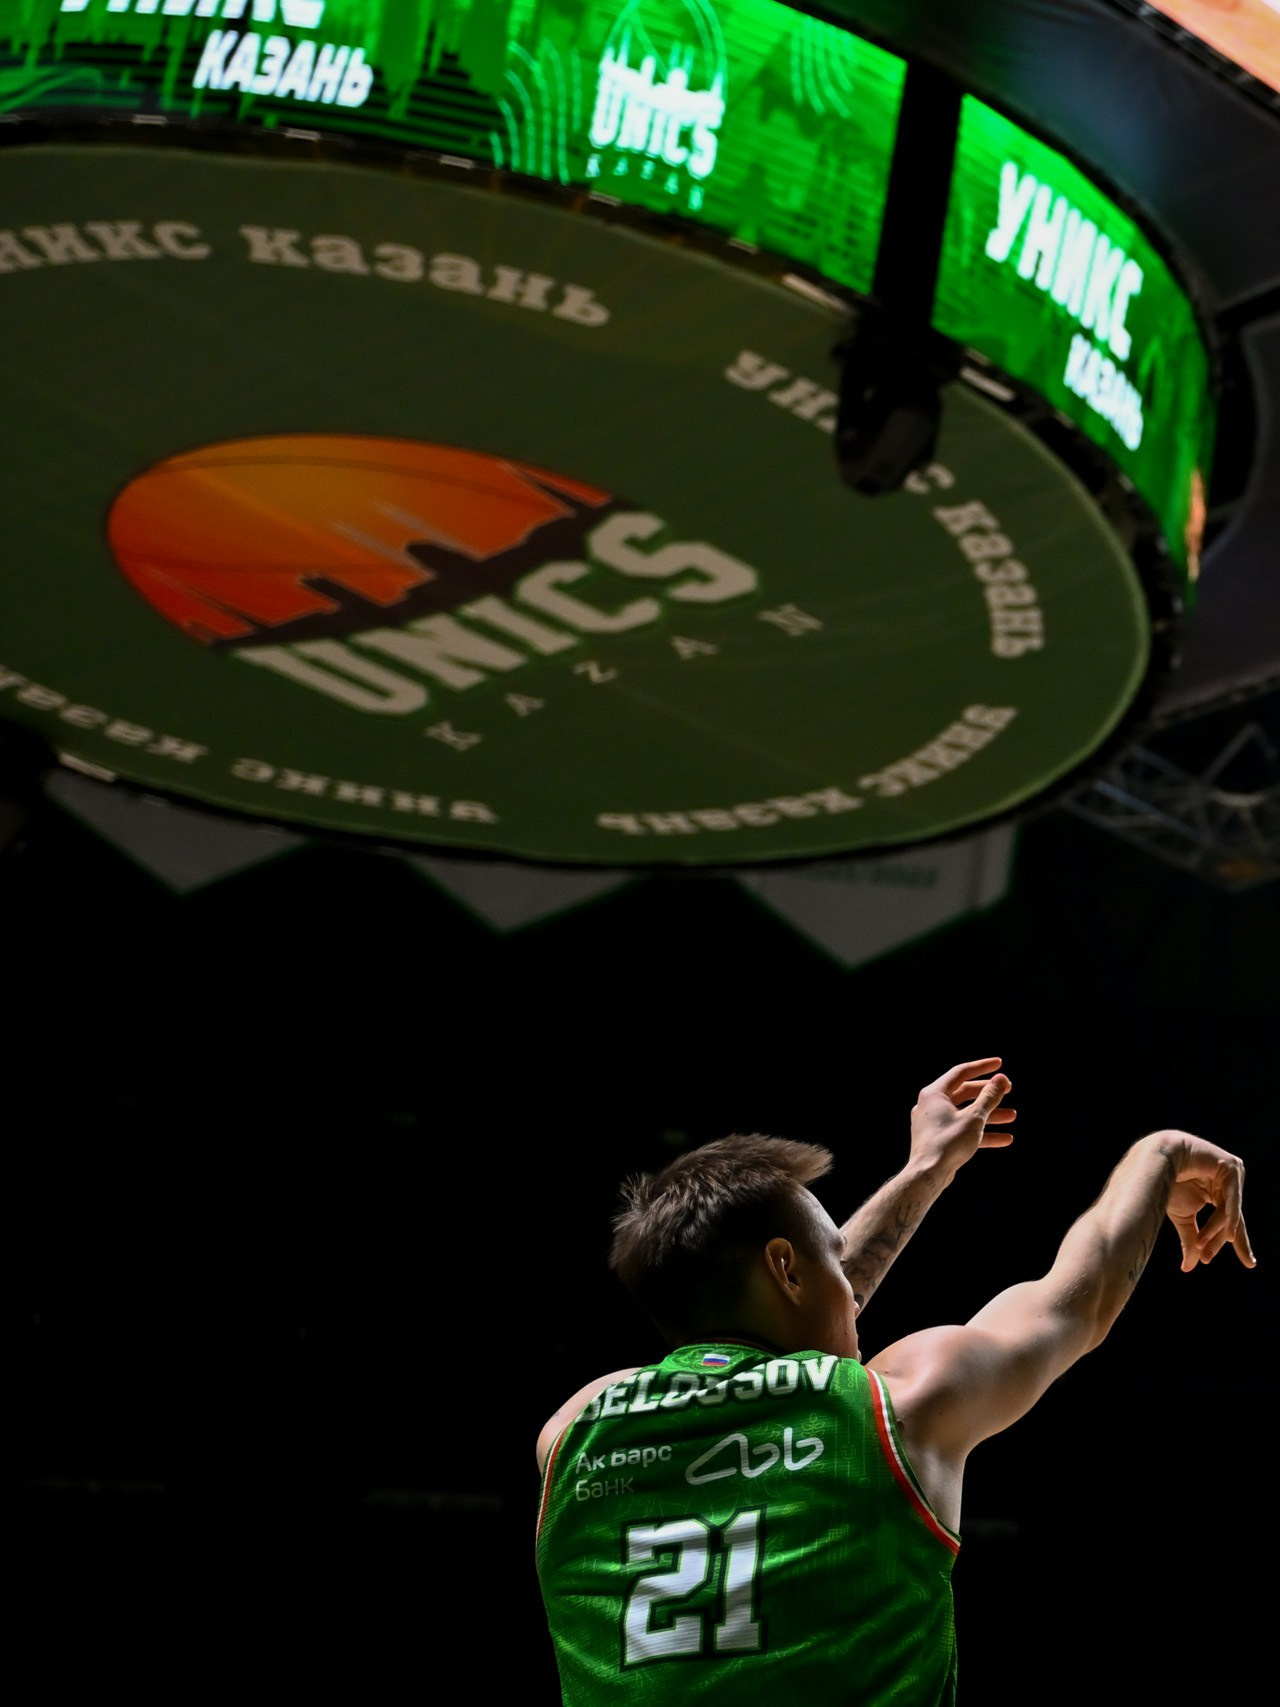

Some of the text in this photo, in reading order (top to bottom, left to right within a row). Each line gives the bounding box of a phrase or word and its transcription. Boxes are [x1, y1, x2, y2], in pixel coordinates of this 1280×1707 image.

[192, 29, 374, 108] КАЗАНЬ
[588, 66, 726, 180] UNICS
[985, 160, 1144, 362] УНИКС
[1063, 333, 1144, 451] КАЗАНЬ
[230, 510, 758, 715] UNICS
[423, 602, 825, 752] KAZAN
[575, 1450, 606, 1475] Ак
[575, 1475, 636, 1502] Банк
[622, 1505, 766, 1670] 21
